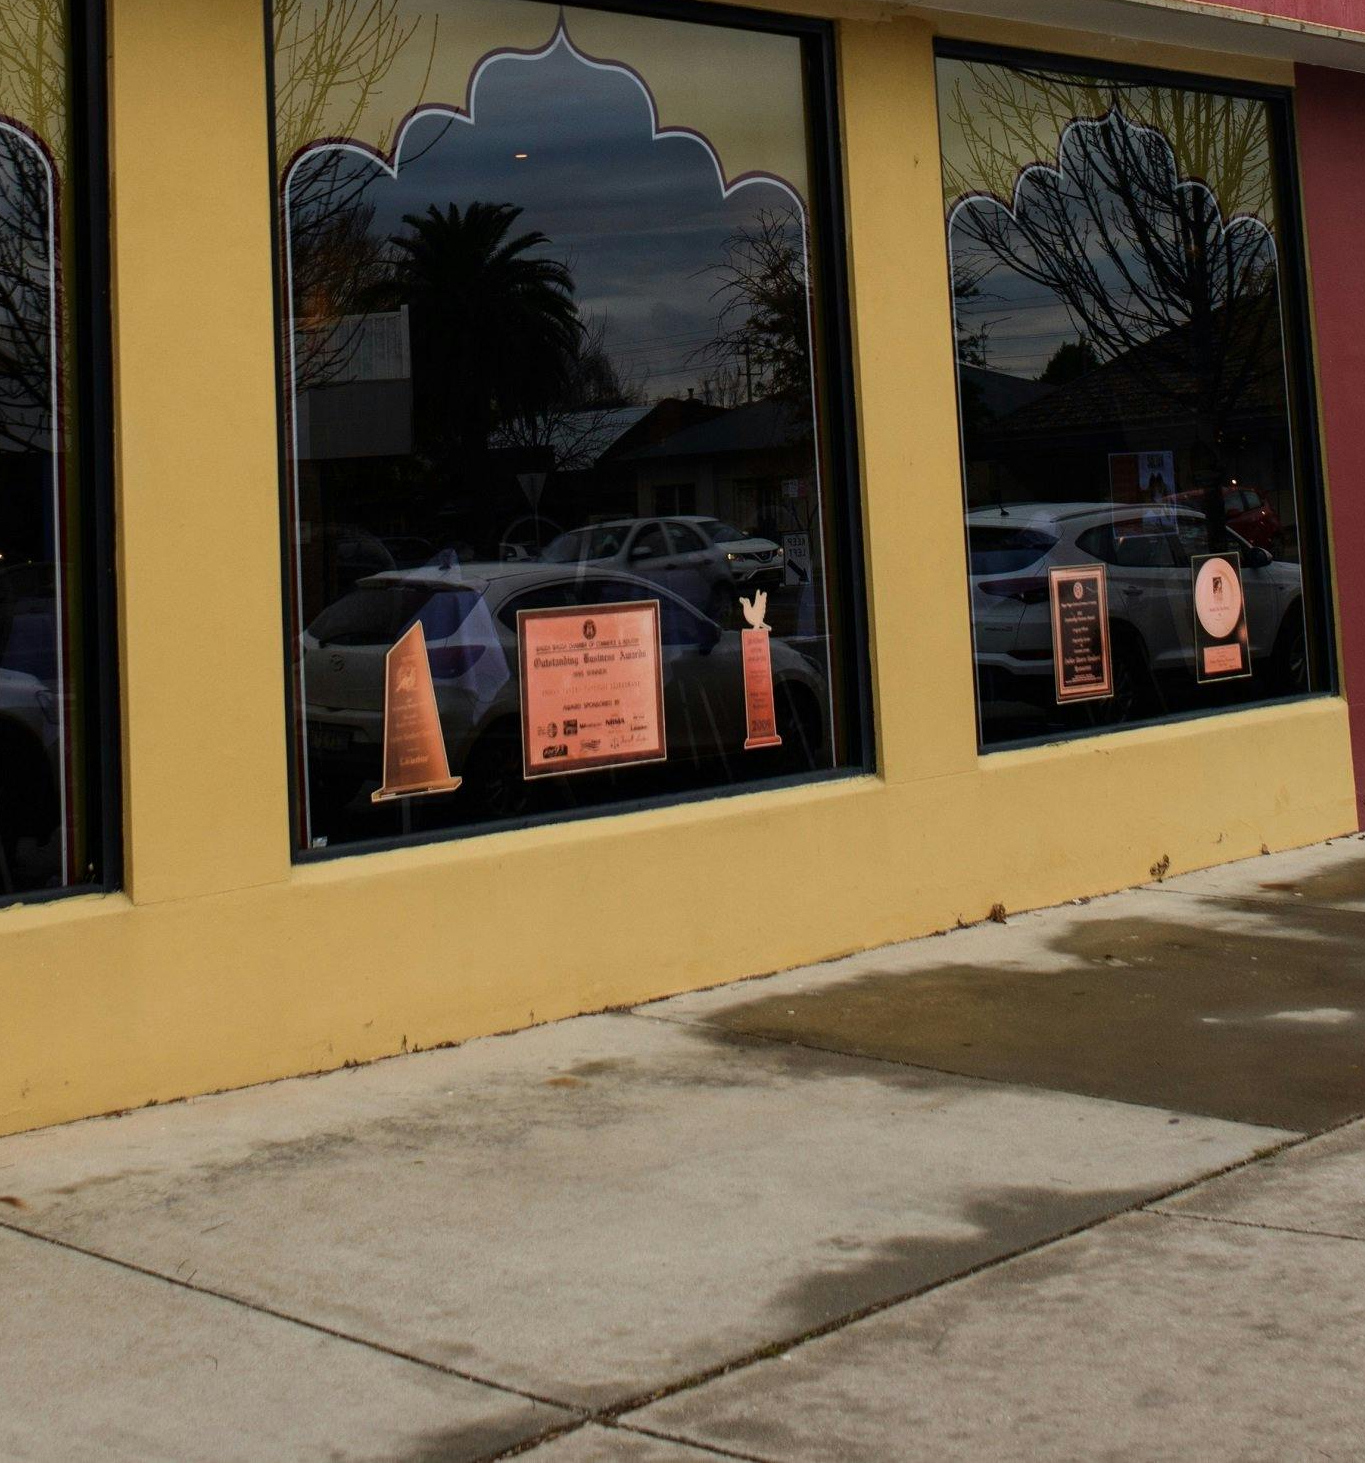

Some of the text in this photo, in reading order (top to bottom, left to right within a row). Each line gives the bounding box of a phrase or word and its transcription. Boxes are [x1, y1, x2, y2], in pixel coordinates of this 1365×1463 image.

[533, 648, 647, 669] Outstanding Business Awards
